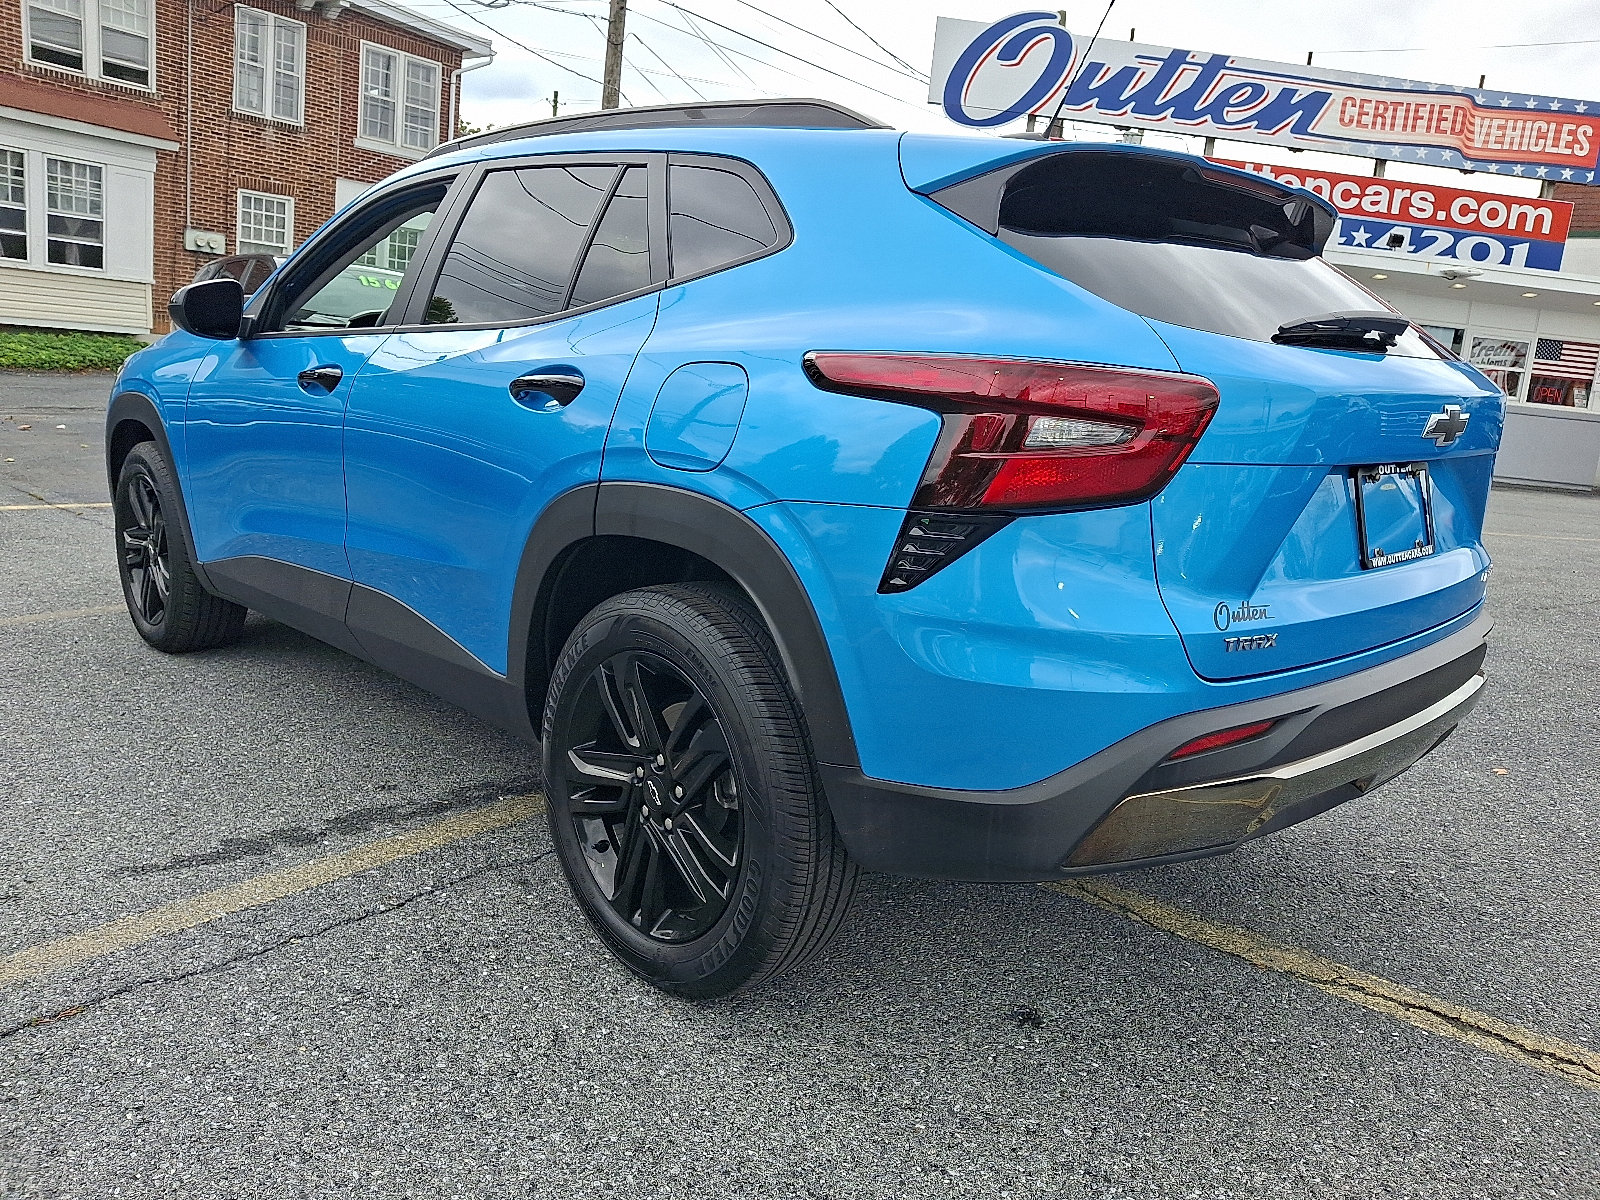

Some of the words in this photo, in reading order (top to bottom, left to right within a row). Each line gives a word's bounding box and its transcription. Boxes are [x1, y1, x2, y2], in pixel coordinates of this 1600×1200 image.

[943, 10, 1333, 137] Outten
[1338, 96, 1467, 138] CERTIFIED
[1473, 114, 1593, 157] VEHICLES
[1533, 386, 1563, 403] OPEN
[1213, 600, 1275, 631] Outten
[1224, 633, 1278, 652] TRAX
